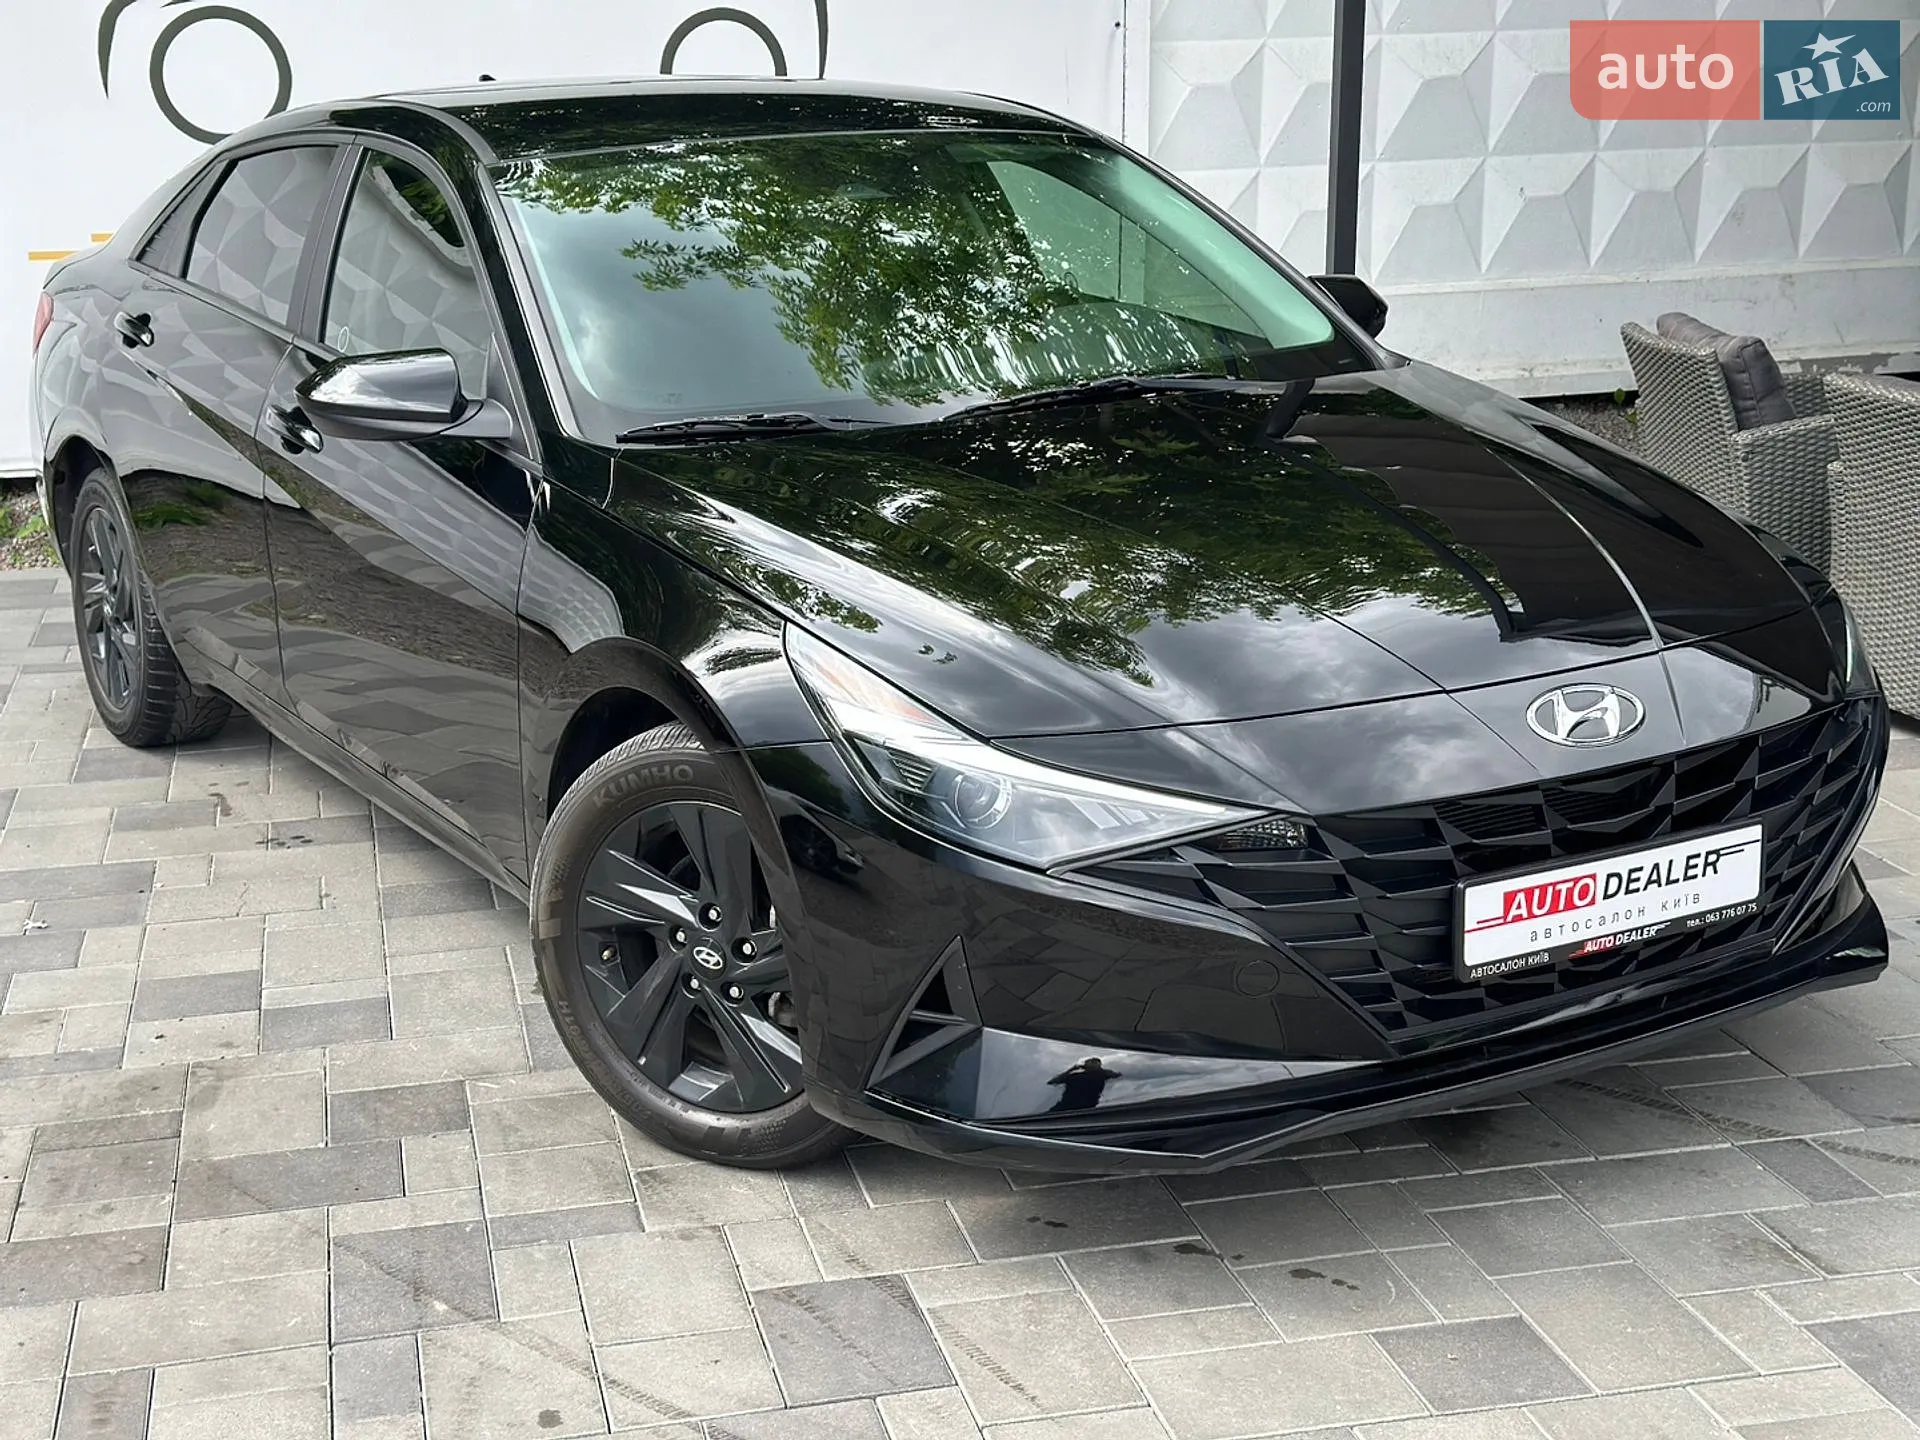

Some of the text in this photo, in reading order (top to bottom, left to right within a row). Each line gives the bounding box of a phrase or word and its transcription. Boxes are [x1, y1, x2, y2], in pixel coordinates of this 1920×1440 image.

[593, 764, 694, 808] KUMHO
[1506, 850, 1722, 923] AUTO DEALER
[1530, 906, 1645, 942] автосалон
[1584, 926, 1658, 953] AUTO DEALER
[1470, 957, 1526, 979] АВТОСАЛОН
